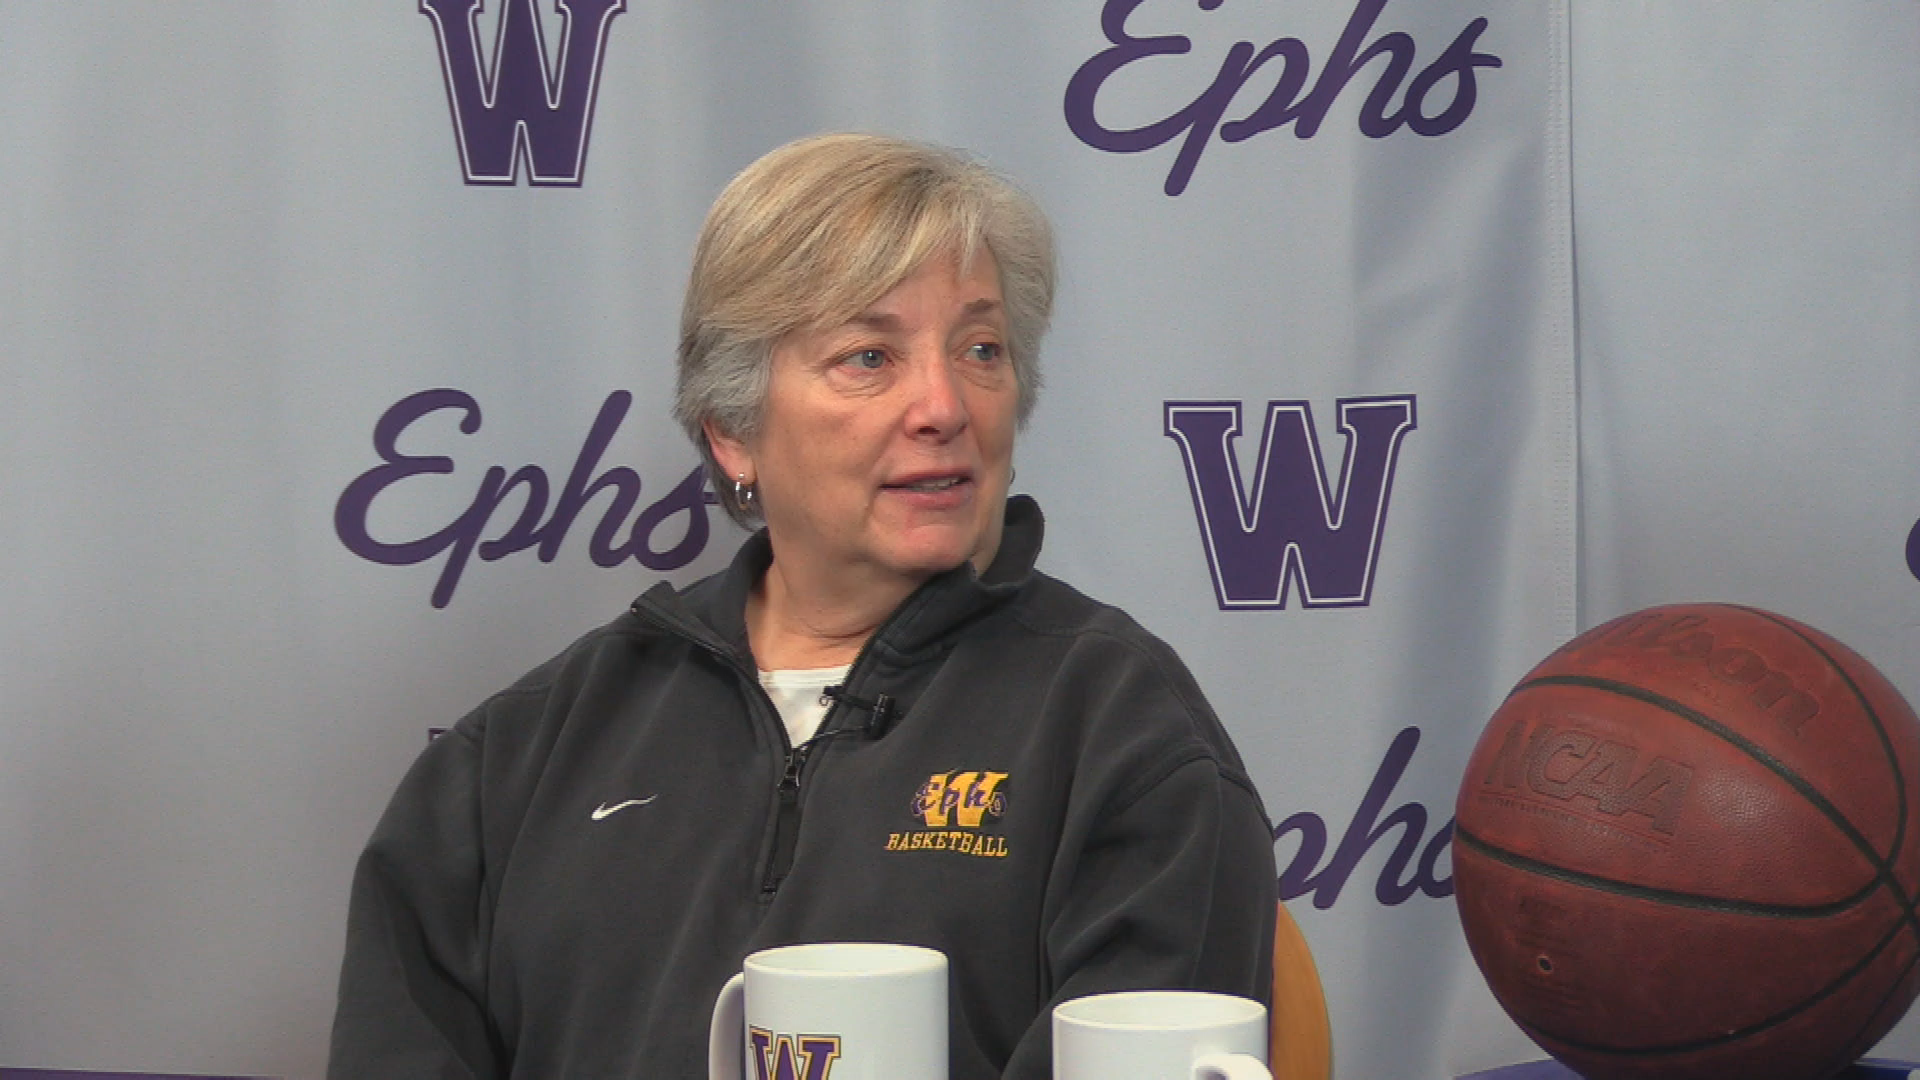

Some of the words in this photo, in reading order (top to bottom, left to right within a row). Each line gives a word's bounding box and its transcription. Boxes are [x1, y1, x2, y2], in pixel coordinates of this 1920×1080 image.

[418, 0, 627, 188] W
[1064, 0, 1502, 197] Ephs
[334, 388, 718, 609] Ephs
[1163, 394, 1417, 610] W
[884, 831, 1008, 857] BASKETBALL
[1484, 719, 1696, 837] NCAA
[749, 1025, 841, 1080] W
